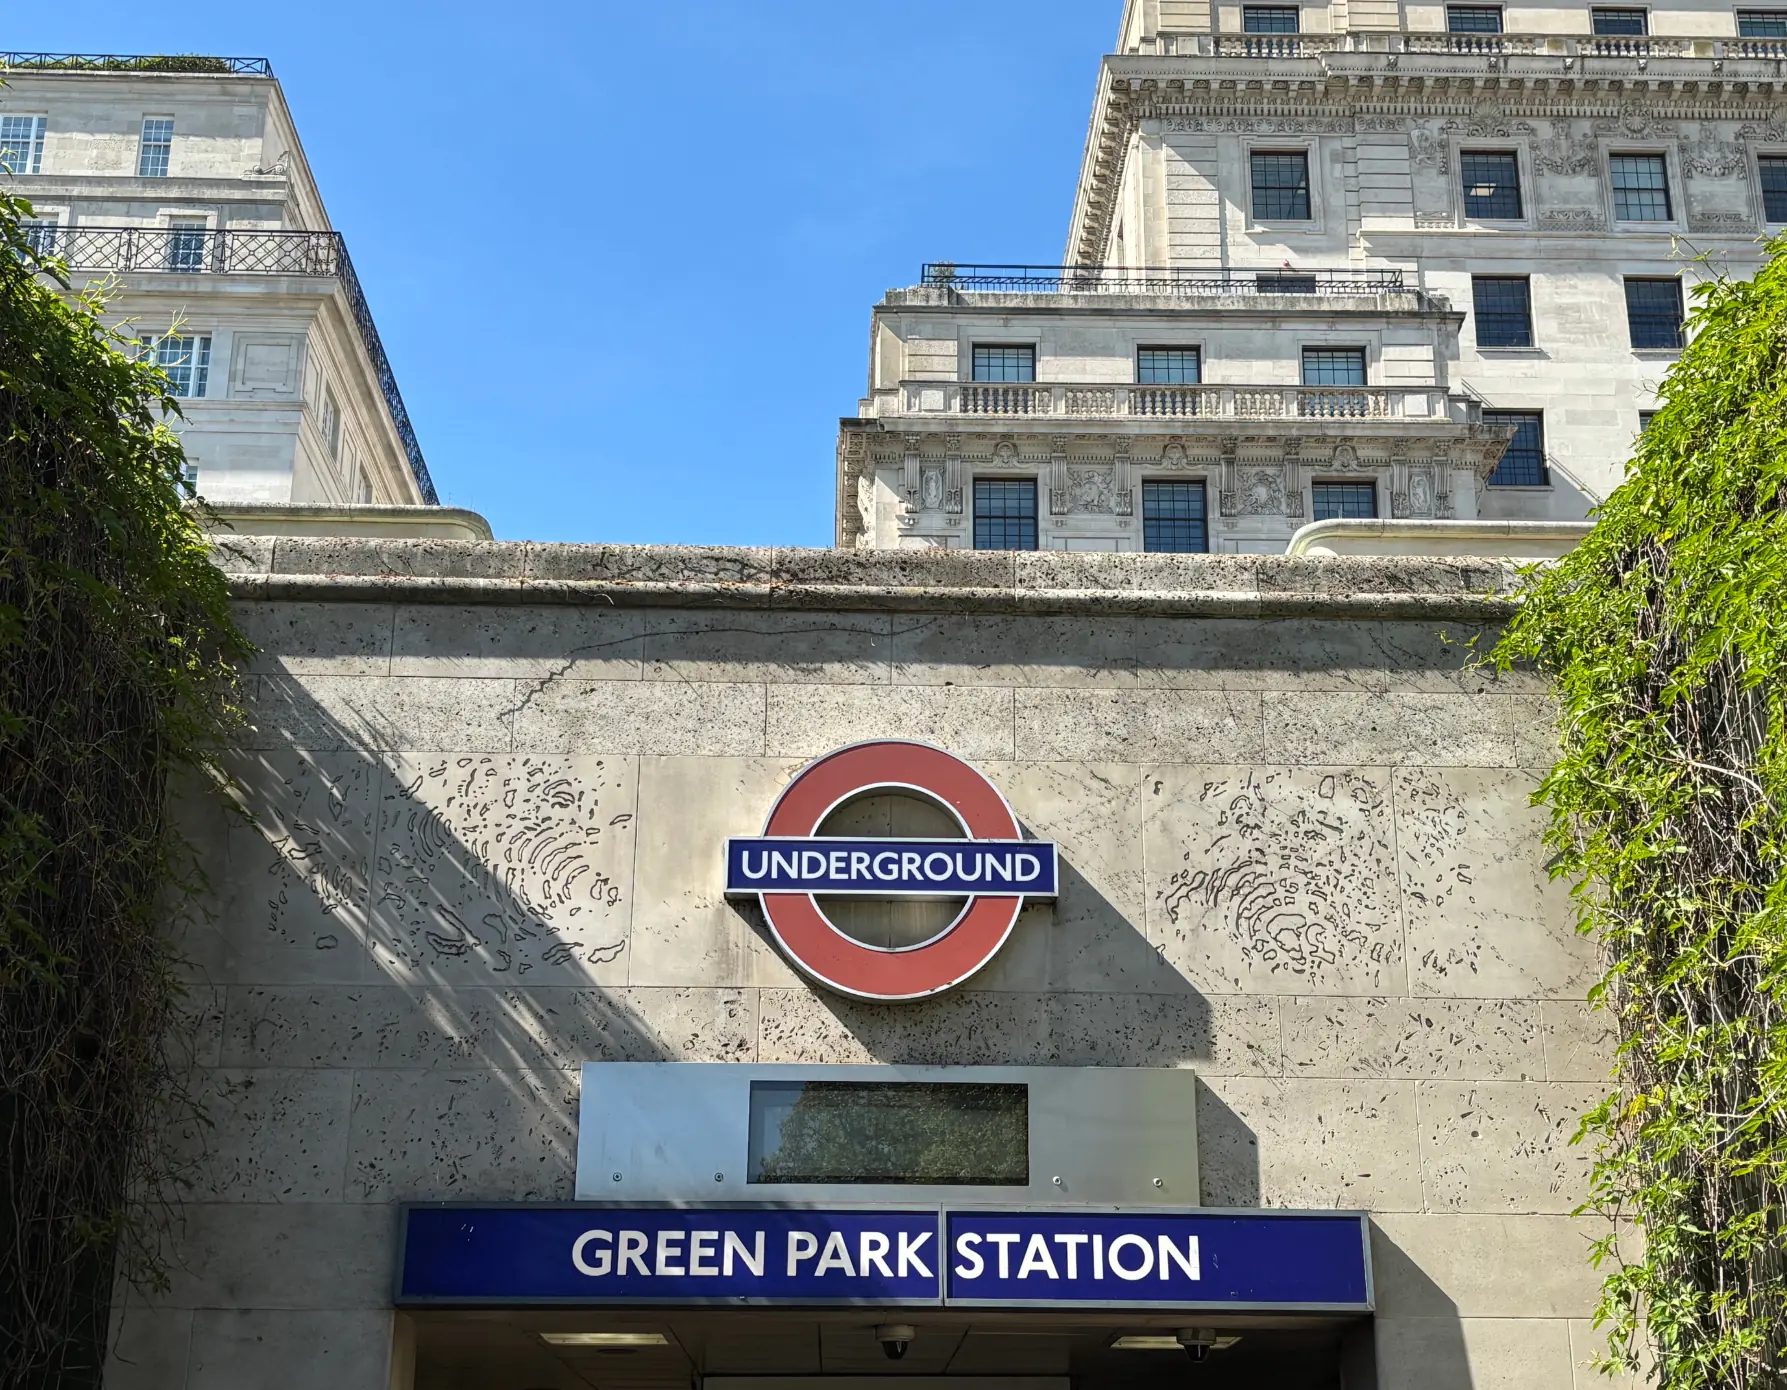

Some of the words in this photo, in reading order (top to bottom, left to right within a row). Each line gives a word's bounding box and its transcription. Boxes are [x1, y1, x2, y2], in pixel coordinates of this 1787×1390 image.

[742, 850, 1041, 882] UNDERGROUND
[572, 1229, 765, 1277] GREEN
[786, 1230, 934, 1278] PARK
[954, 1232, 1201, 1281] STATION
